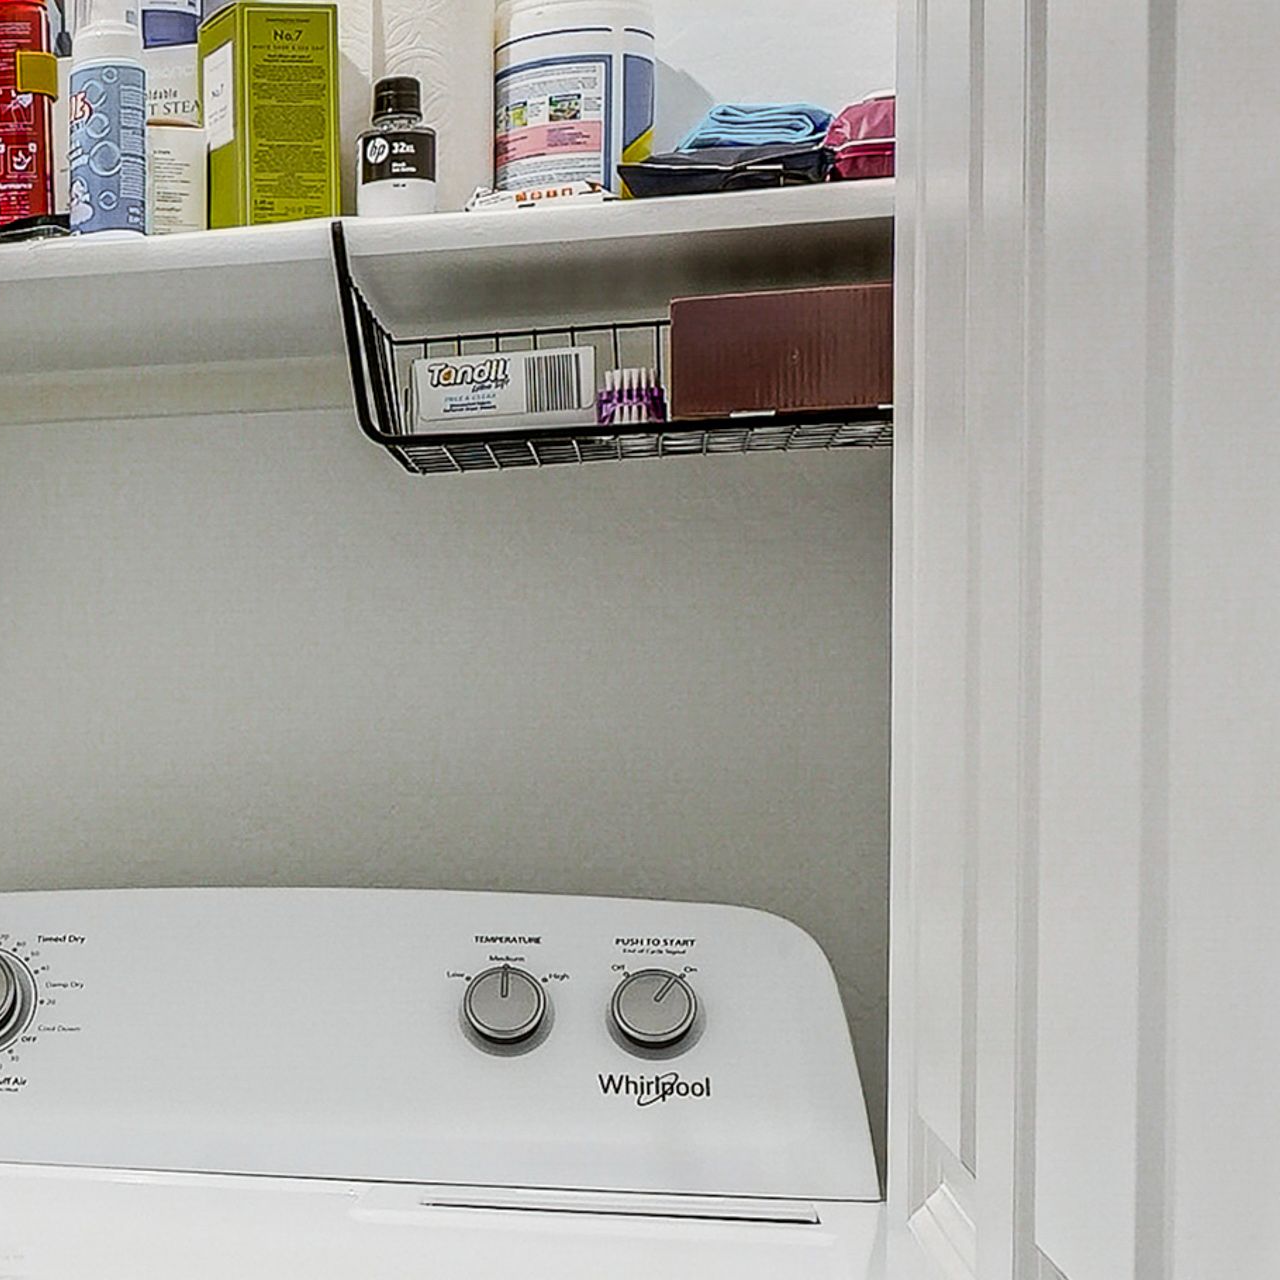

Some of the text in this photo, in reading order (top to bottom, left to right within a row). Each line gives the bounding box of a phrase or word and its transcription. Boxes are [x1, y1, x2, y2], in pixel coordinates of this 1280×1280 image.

[274, 29, 302, 41] No.7
[427, 357, 508, 388] Tandil
[68, 934, 86, 945] Dry
[474, 935, 541, 944] TEMPERATURE
[615, 938, 696, 947] PUSH TO START
[598, 1072, 711, 1106] Whirlpool
